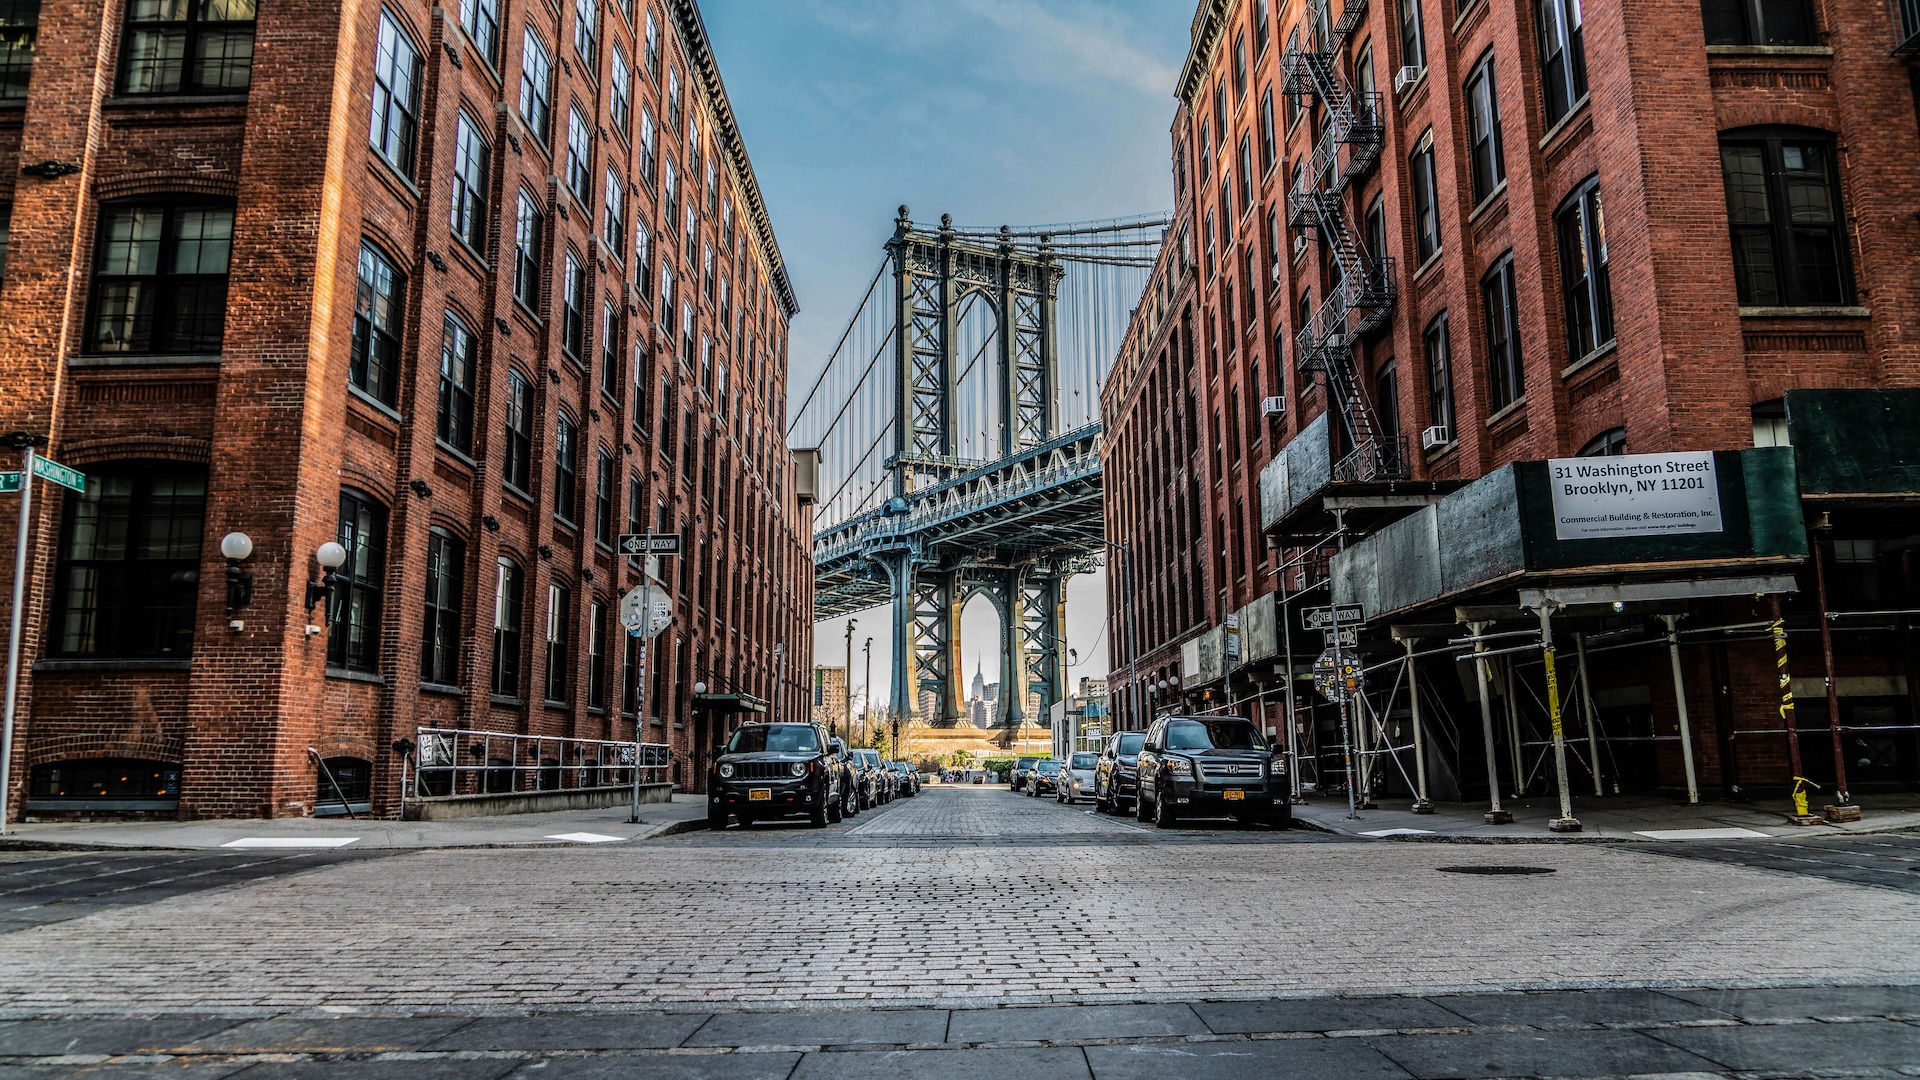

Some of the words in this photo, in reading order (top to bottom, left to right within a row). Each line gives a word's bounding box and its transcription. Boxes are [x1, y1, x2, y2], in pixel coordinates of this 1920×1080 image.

[35, 457, 76, 486] WASHINGTON
[1555, 466, 1572, 478] 31
[1576, 463, 1662, 478] Washington
[1666, 460, 1710, 473] Street
[10, 474, 18, 482] ST
[1564, 481, 1633, 496] Brooklyn,
[1636, 479, 1656, 492] NY
[1661, 477, 1705, 491] 11201
[1560, 514, 1607, 524] Commercial
[1609, 511, 1642, 521] Building
[1651, 510, 1699, 519] Restoration,
[628, 540, 646, 549] ONE
[653, 540, 672, 548] WAY
[1312, 613, 1330, 622] ONE
[1337, 610, 1356, 620] WAY
